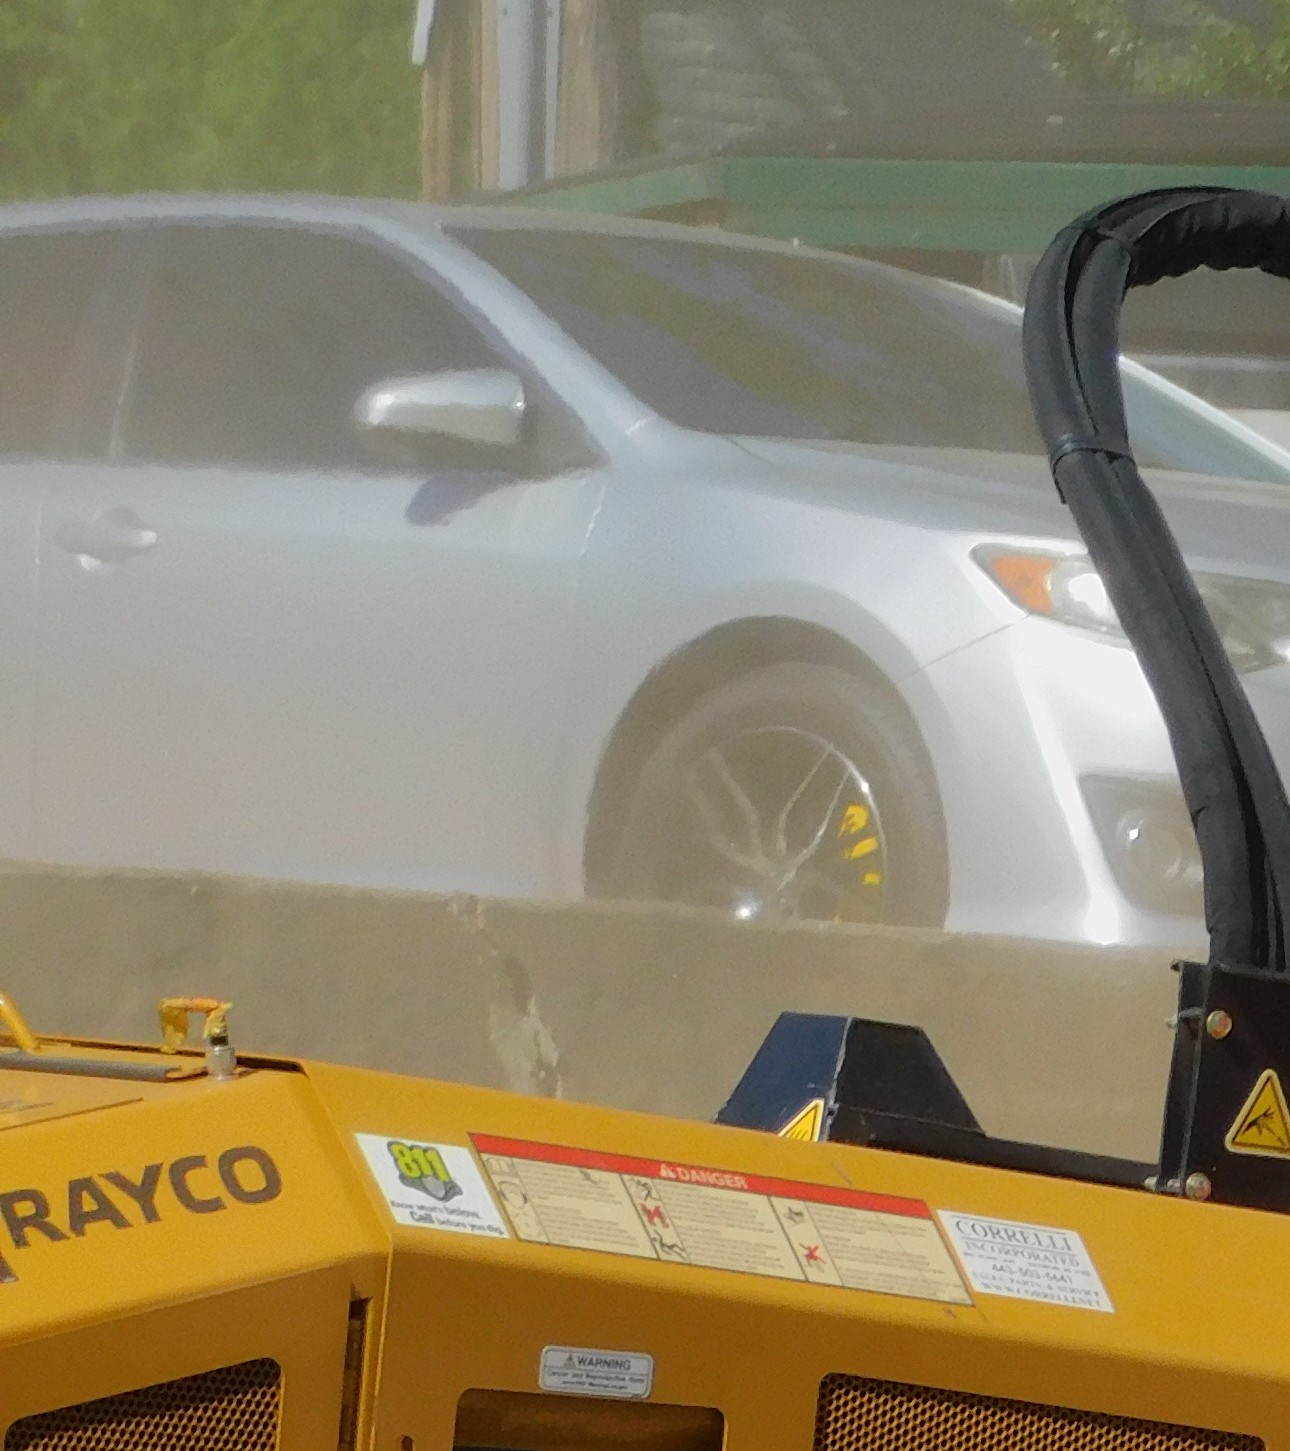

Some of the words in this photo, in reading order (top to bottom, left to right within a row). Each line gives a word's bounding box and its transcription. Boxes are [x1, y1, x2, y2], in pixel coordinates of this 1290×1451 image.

[389, 1142, 451, 1182] 811
[677, 1166, 749, 1190] DANGER
[0, 1145, 283, 1250] RAYCO
[955, 1219, 1073, 1252] CORRELLI
[576, 1355, 632, 1371] WARNING
